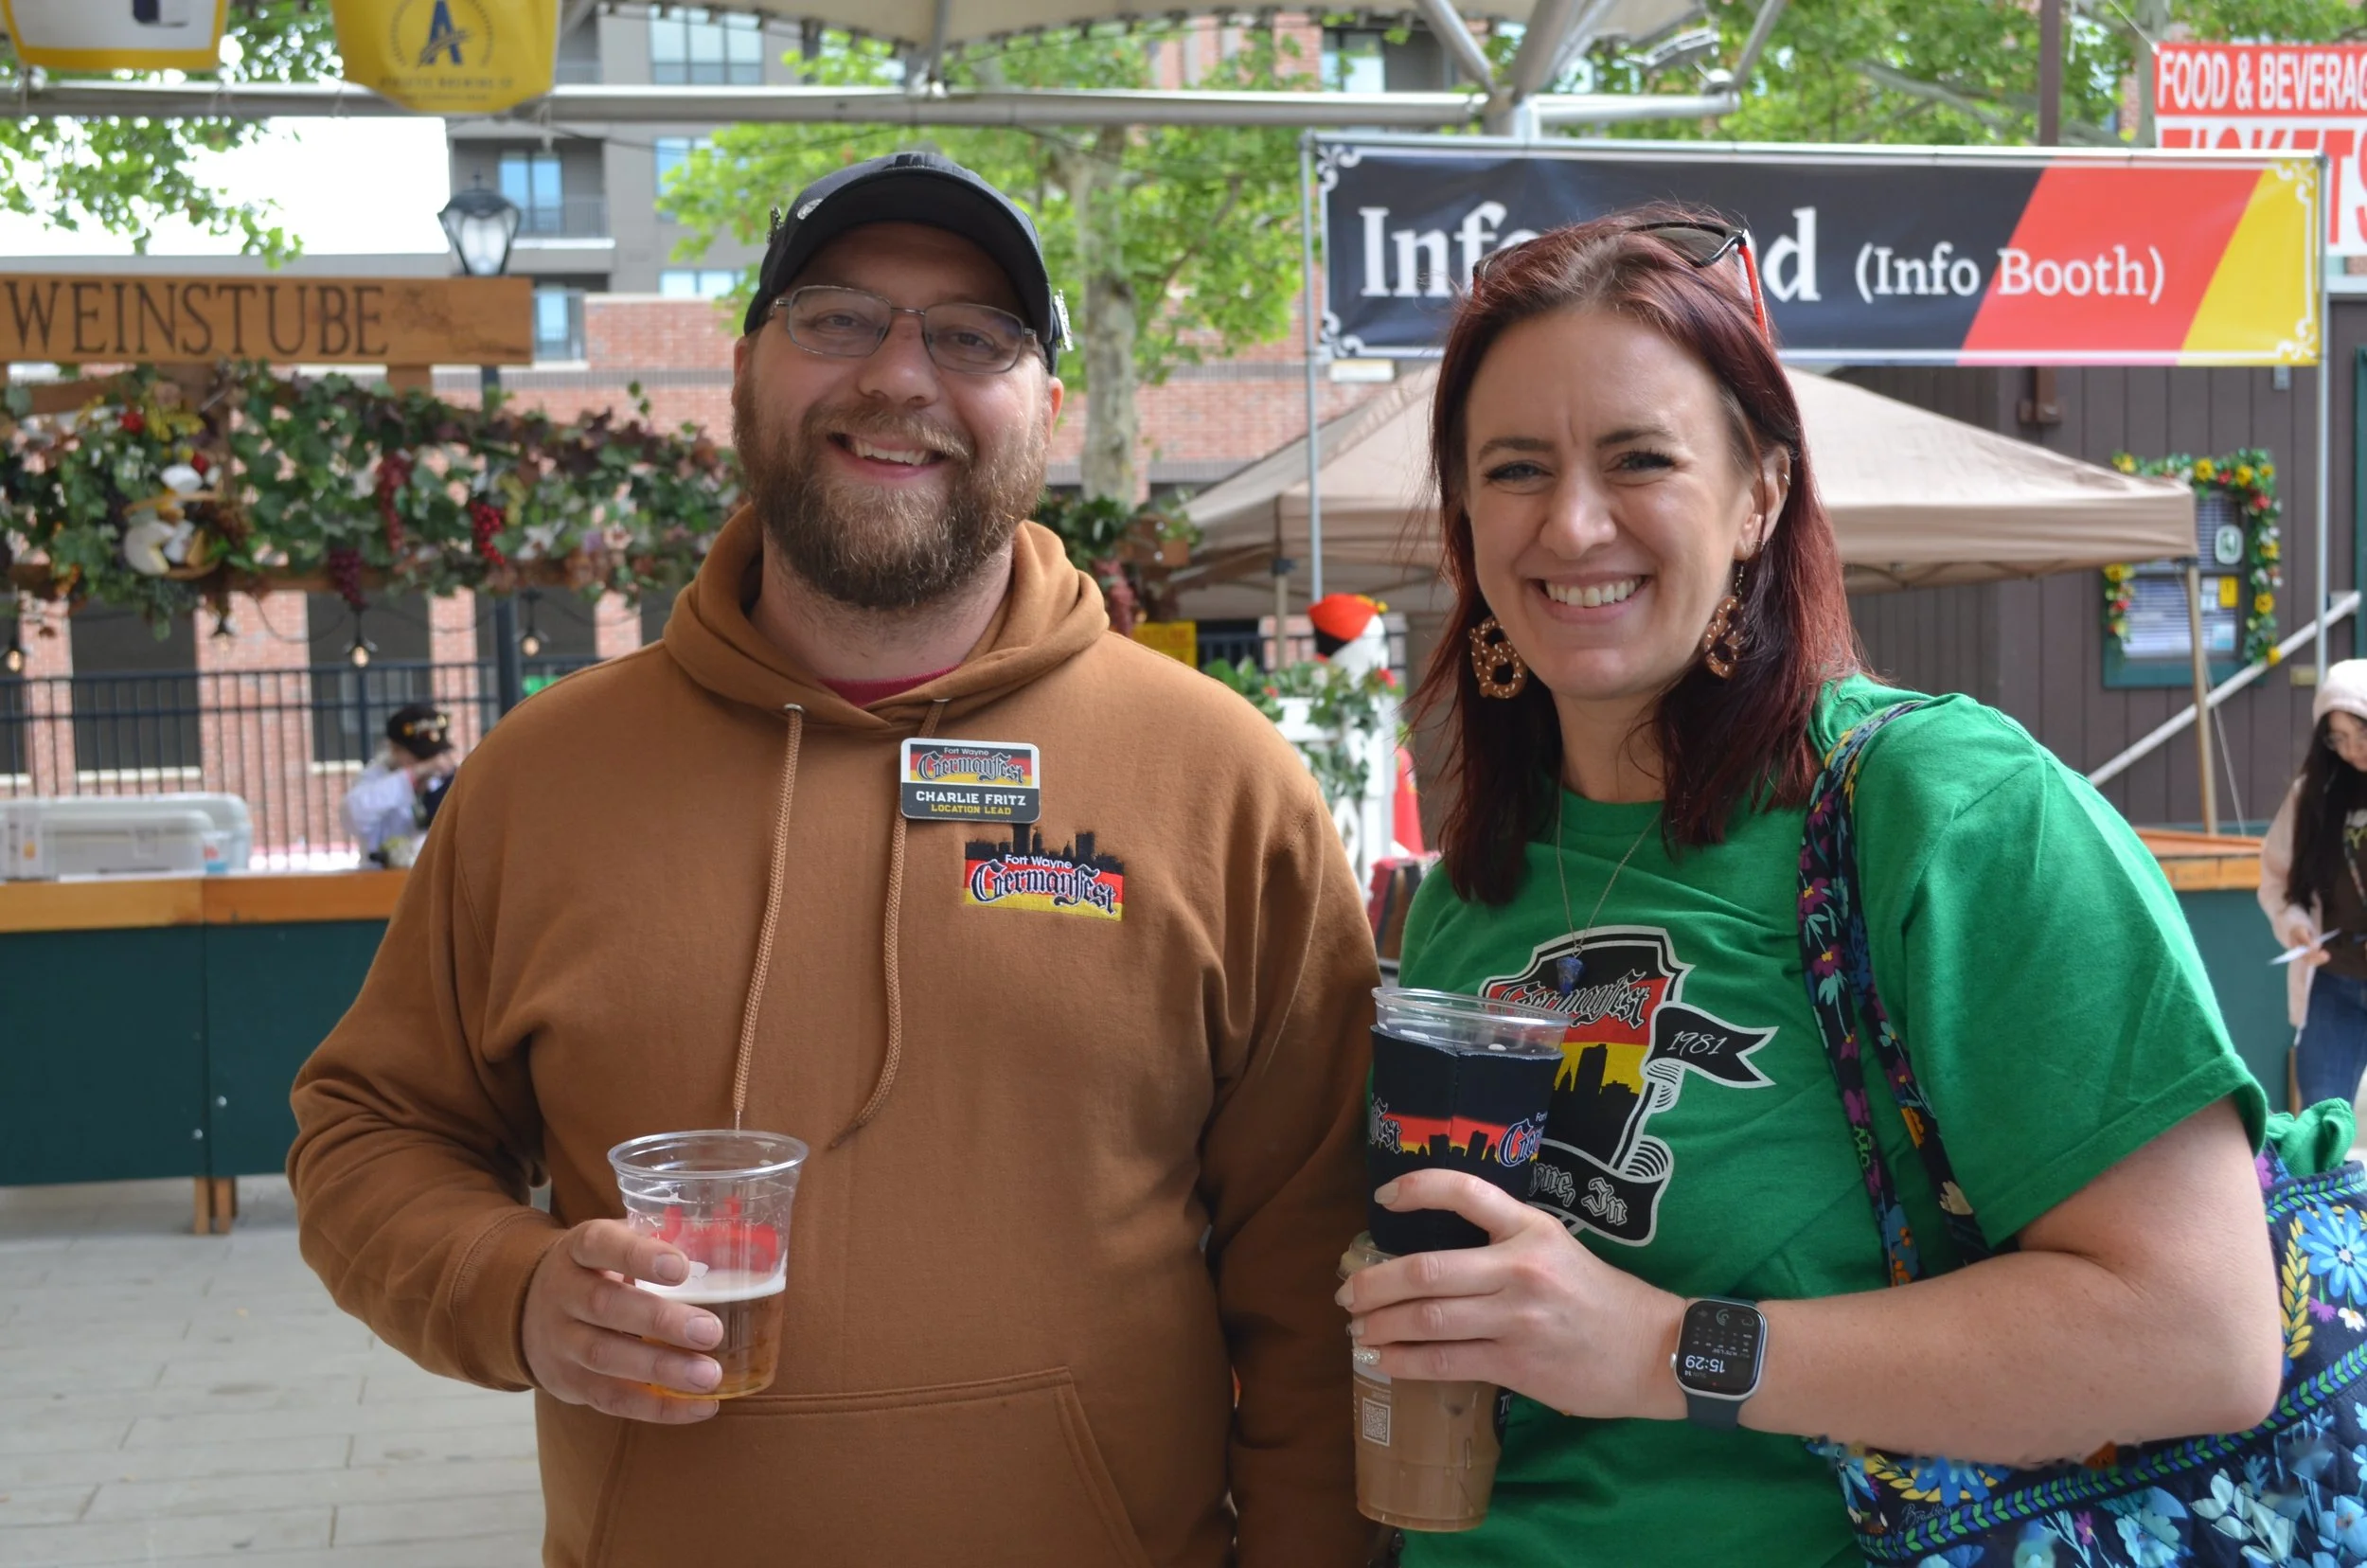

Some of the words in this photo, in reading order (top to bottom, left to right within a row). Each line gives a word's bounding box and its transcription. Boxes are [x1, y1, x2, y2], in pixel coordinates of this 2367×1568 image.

[2158, 50, 2231, 111] FOOD
[2234, 51, 2254, 111] &
[1855, 241, 1981, 304] (Info
[1997, 243, 2165, 305] Booth)
[4, 282, 388, 357] WEINSTUBE
[944, 746, 959, 756] Fort
[961, 747, 989, 757] Wayne
[916, 790, 979, 805] CHARLIE
[985, 793, 1026, 806] FRITZ
[931, 804, 981, 814] LOCATION
[984, 807, 1012, 815] LEAD
[1005, 853, 1028, 864] Fort
[1030, 855, 1073, 869] Wayne
[1666, 1029, 1728, 1057] 1981
[1684, 1354, 1725, 1374] 15:29
